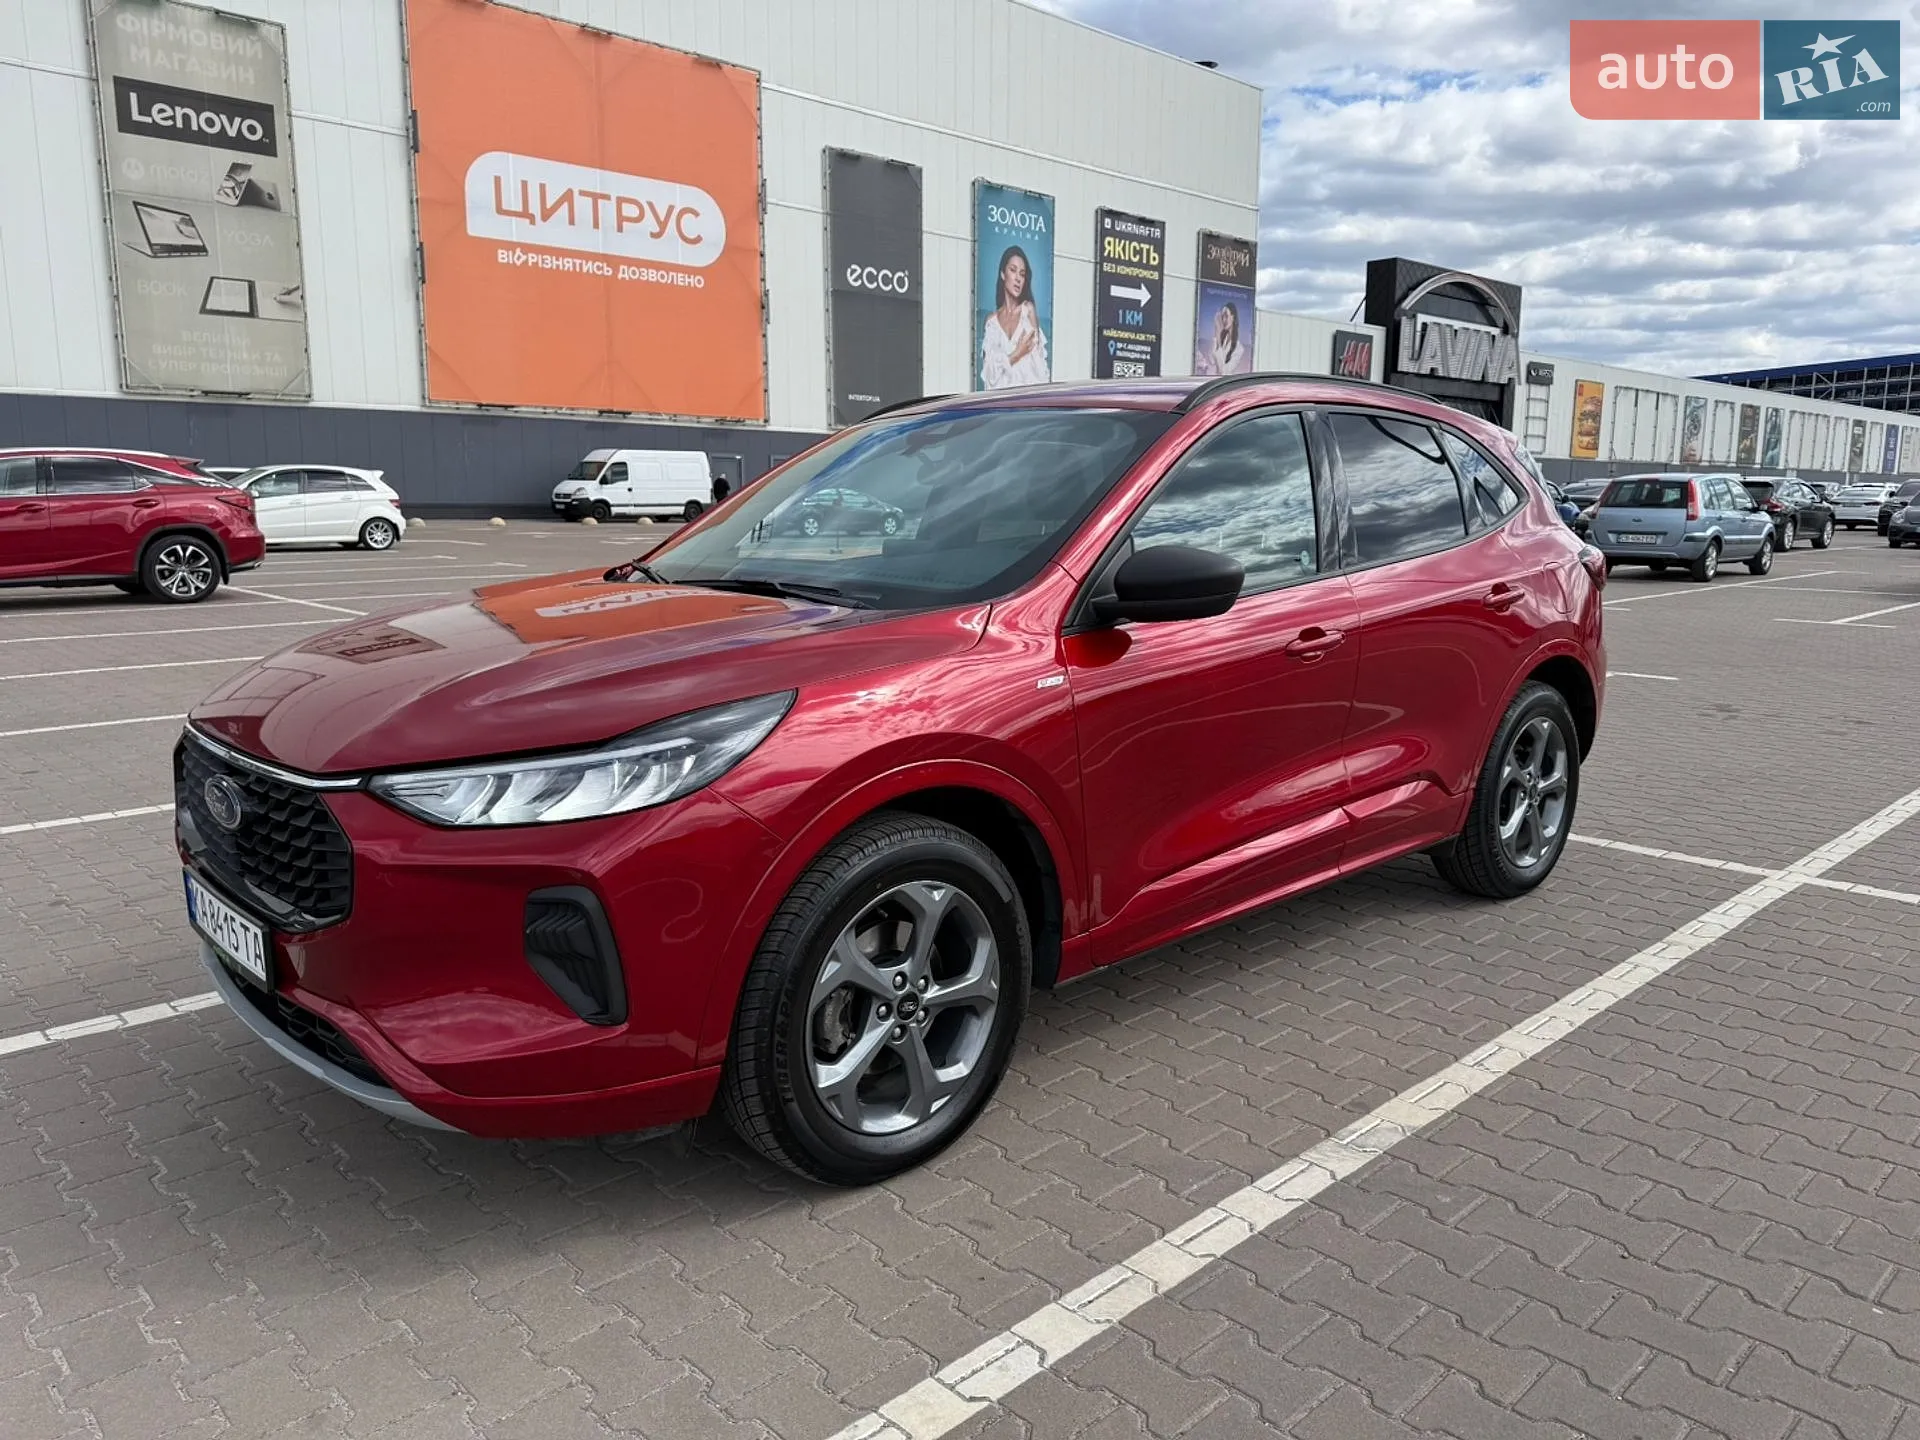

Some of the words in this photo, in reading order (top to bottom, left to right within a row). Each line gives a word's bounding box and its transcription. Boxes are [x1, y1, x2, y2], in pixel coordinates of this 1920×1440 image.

[116, 12, 263, 60] ФІРМОВИЙ
[129, 43, 256, 86] МАГАЗИН
[129, 91, 264, 142] Lenovo
[493, 174, 704, 246] ЦИТРУС
[988, 204, 1047, 232] ЗОЛОТА
[1103, 236, 1160, 266] ЯКІСТЬ
[1219, 260, 1238, 278] ВІК
[617, 263, 705, 289] ДОЗВОЛЕНО
[846, 264, 910, 293] ecco
[1398, 314, 1521, 385] LAVINA
